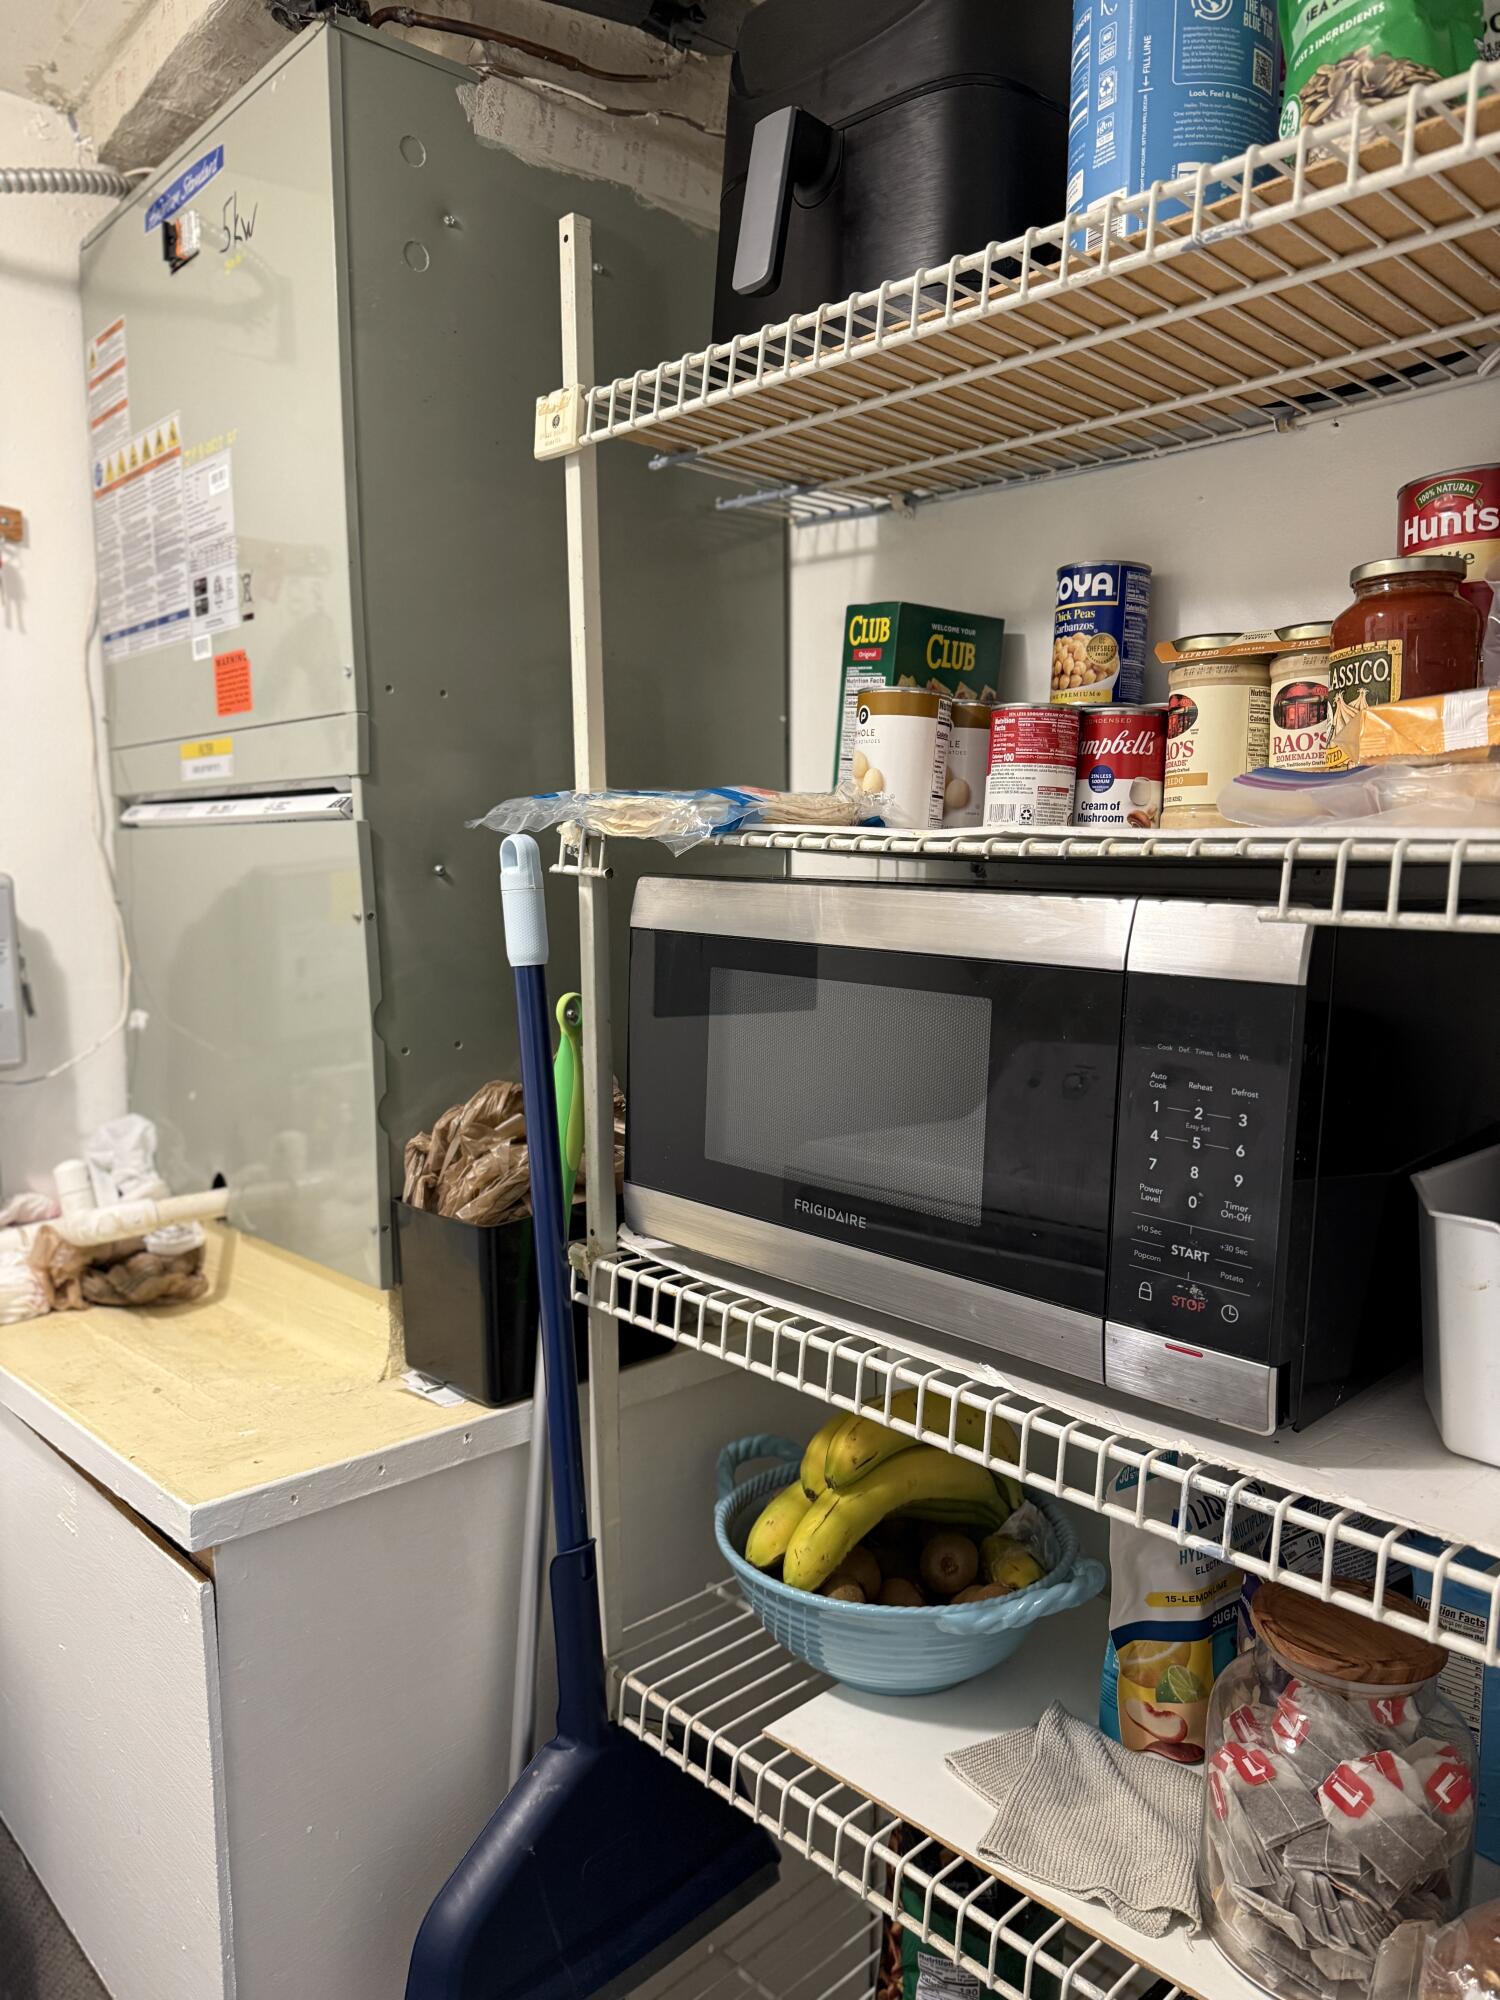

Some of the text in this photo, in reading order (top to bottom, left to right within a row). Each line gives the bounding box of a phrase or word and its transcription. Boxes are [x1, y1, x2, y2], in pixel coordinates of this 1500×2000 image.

[1315, 1, 1385, 50] INGREDIENTS
[1142, 34, 1152, 75] FILL LINE
[1418, 482, 1475, 505] 100% NATURAL
[1073, 609, 1096, 621] Peas
[849, 615, 890, 647] CLUB
[931, 622, 977, 637] WELCOME YOUR
[926, 633, 976, 672] CLUB
[1178, 649, 1220, 660] ALFREDO
[1080, 729, 1156, 760] ampbell's
[1003, 753, 1015, 762] 100
[1080, 800, 1121, 811] Cream of
[1077, 813, 1124, 824] Mushroom
[1157, 1043, 1173, 1051] Cook
[1217, 1051, 1232, 1059] Lock
[1150, 1071, 1168, 1080] Auto
[1149, 1080, 1167, 1090] Cook
[1188, 1081, 1213, 1092] Reheat
[1231, 1087, 1259, 1099] Defrost
[1152, 1100, 1160, 1113] 1
[1193, 1106, 1203, 1120] 2
[1238, 1113, 1248, 1127] 3
[1185, 1122, 1211, 1133] Easy Set
[1149, 1129, 1160, 1142] 4
[1191, 1136, 1201, 1150] 5
[1235, 1144, 1246, 1158] 6
[1148, 1157, 1158, 1170] 7
[1190, 1165, 1199, 1179] 8
[1233, 1174, 1244, 1188] 9
[1139, 1183, 1163, 1195] Power
[1140, 1192, 1161, 1204] Level
[1187, 1195, 1198, 1209] 0
[1223, 1199, 1249, 1213] Timer
[794, 1198, 867, 1230] FRIGIDAIRE
[1220, 1209, 1252, 1224] On-Off
[1149, 1228, 1163, 1237] Sec
[1133, 1249, 1162, 1263] Popcorn
[1170, 1243, 1211, 1263] START
[1235, 1247, 1249, 1257] Sec
[1220, 1271, 1245, 1284] Potato
[1171, 1294, 1207, 1313] STOP
[1212, 1608, 1239, 1628] SUGA
[1458, 1609, 1486, 1629] Facts
[1332, 1778, 1364, 1808] L
[1434, 1771, 1453, 1804] L
